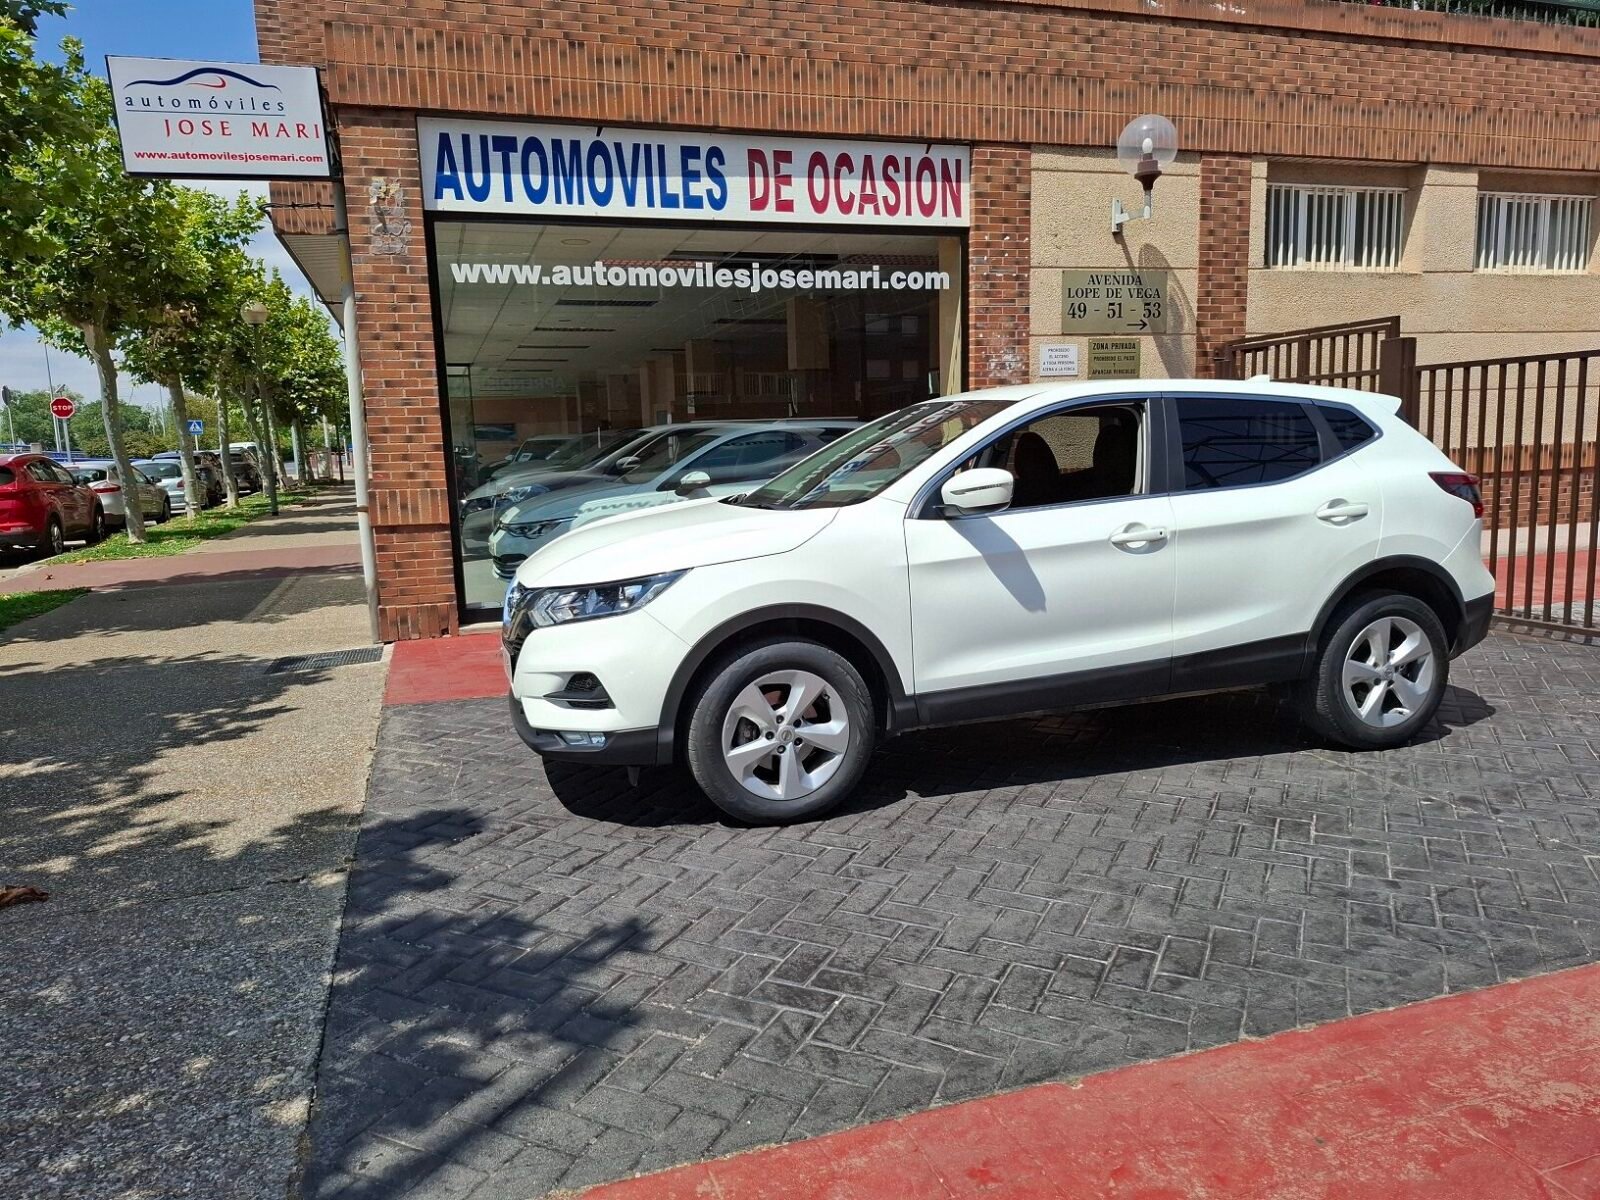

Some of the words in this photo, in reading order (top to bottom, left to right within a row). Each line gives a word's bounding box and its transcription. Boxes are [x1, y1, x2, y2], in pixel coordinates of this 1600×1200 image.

[124, 95, 285, 112] automóviles
[164, 119, 232, 138] JOSE
[252, 121, 321, 139] MARI
[134, 151, 323, 163] www.automovilesjosemari.com
[434, 126, 728, 212] AUTOMÓVILES
[748, 148, 794, 213] DE
[807, 143, 963, 218] OCASIÓN
[450, 261, 950, 293] www.automovilesjosemari.com
[1088, 274, 1143, 286] AVENIDA
[1067, 288, 1100, 299] LOPE
[1106, 288, 1122, 299] DE
[1128, 288, 1161, 299] VEGA
[1067, 302, 1087, 319] 49
[1107, 302, 1123, 319] 51
[1143, 302, 1162, 319] 53
